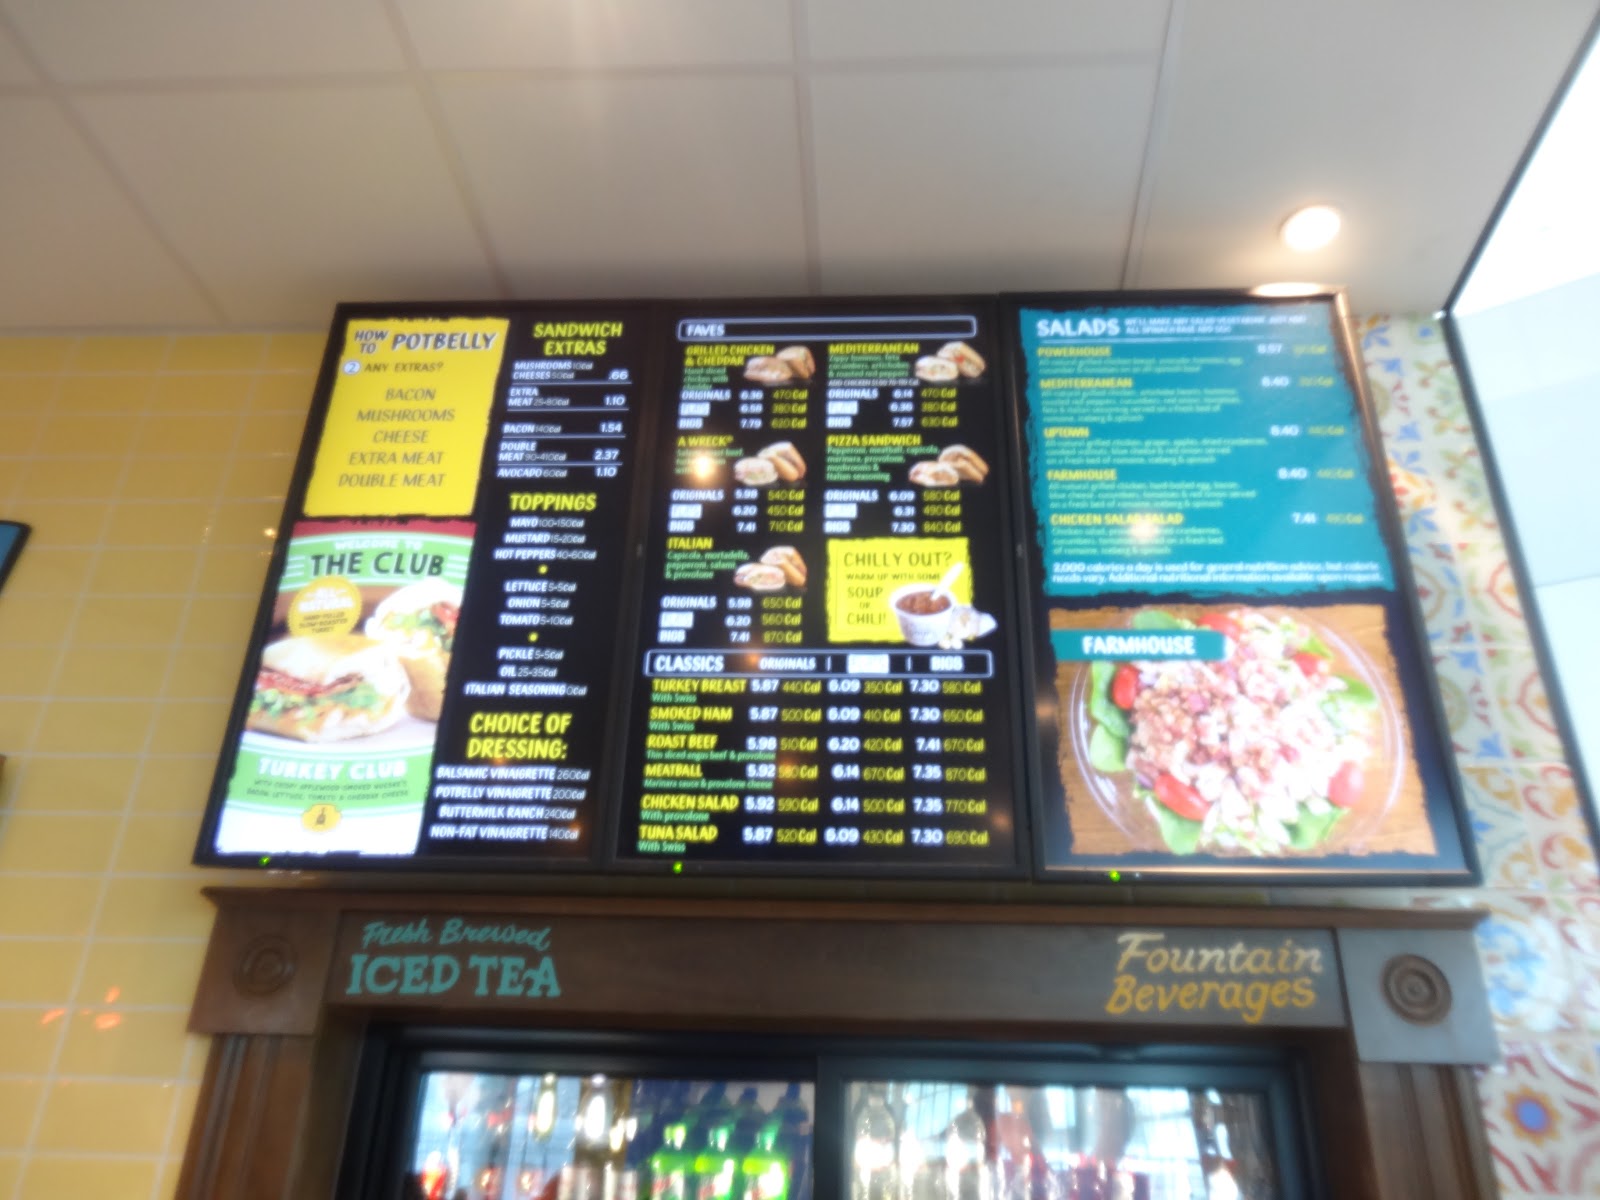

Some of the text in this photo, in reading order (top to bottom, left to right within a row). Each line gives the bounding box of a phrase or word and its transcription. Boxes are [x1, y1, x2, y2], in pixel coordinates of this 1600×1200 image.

[533, 322, 623, 338] SANDWICH
[686, 324, 725, 336] FAVES
[1037, 319, 1120, 337] SALADS
[354, 330, 388, 342] HOW
[392, 332, 497, 351] POTBELLY
[359, 343, 377, 354] TO
[544, 340, 607, 355] EXTRAS
[686, 344, 774, 355] GRILLED CHICKEN
[828, 343, 920, 353] MEDITERRANEAN
[514, 361, 572, 370] MUSHROOMS
[697, 356, 745, 366] CHEDDAR
[364, 363, 444, 372] ANY EXTRAS?
[512, 371, 550, 380] CHEESES
[385, 388, 436, 401] BACON
[510, 388, 538, 396] EXTRA
[508, 398, 533, 406] MEAT
[605, 396, 625, 406] 1.10
[356, 409, 455, 422] MUSHROOMS
[503, 424, 535, 433] BACON
[600, 423, 622, 433] 1.54
[373, 430, 429, 444] CHEESE
[677, 436, 686, 447] A
[827, 435, 922, 446] PIZZA SANDWICH
[500, 442, 537, 451] DOUBLE
[349, 452, 445, 465] EXTRA MEAT
[499, 452, 524, 461] MEAT
[595, 450, 619, 460] 2.37
[498, 469, 542, 477] AVOCADO
[595, 467, 617, 477] 1.10
[338, 474, 445, 487] DOUBLE MEAT
[671, 490, 724, 501] ORIGINALS
[825, 490, 879, 502] ORIGINALS
[510, 493, 597, 511] TOPPINGS
[510, 518, 538, 527] MAYO
[1051, 514, 1102, 525] CHICKEN
[504, 534, 550, 543] MUSTARD
[667, 537, 713, 549] ITALIAN
[494, 549, 514, 559] HOT
[515, 549, 556, 559] PEPPERS
[844, 552, 952, 567] CHILLY OUT?
[311, 552, 445, 576] THE CLUB
[505, 582, 548, 592] LETTUCE
[848, 587, 883, 598] SOUP
[508, 598, 540, 608] ONION
[661, 596, 717, 609] ORIGINALS
[500, 614, 540, 624] TOMATO
[1082, 636, 1196, 654] FARMHOUSE
[498, 649, 534, 660] PICKLE
[655, 656, 816, 672] CLASSICS ORIGINALS
[500, 666, 517, 677] OIL
[465, 684, 566, 695] ITALIAN SEASONING
[653, 679, 700, 693] TURKEY
[701, 680, 747, 693] BREAST
[650, 706, 701, 720] SMOKED
[703, 707, 733, 720] HAM
[470, 713, 572, 734] CHOICE OF
[647, 735, 686, 749] ROAST
[688, 735, 718, 749] BEEF
[467, 738, 568, 759] DRESSING:
[259, 758, 407, 780] TURKEY CLUB
[437, 767, 488, 779] BALSAMIC
[490, 767, 555, 780] VINAIGRETTE
[644, 764, 703, 778] MEATBALL
[435, 786, 485, 799] POTBELLY
[487, 787, 552, 800] VINAIGRETTE
[641, 795, 696, 809] CHICKEN
[697, 795, 739, 811] SALAD
[439, 805, 506, 819] BUTTERMILK
[506, 806, 544, 819] RANCH
[431, 825, 478, 838] NON-FAT
[479, 826, 548, 839] VINAIGRETTE
[639, 825, 674, 839] TUNA
[676, 826, 718, 842] SALAD
[362, 917, 551, 951] Fresh Brewed
[1117, 933, 1322, 974] Fountain
[346, 954, 561, 997] ICED TEA
[1105, 974, 1316, 1024] Beverages
